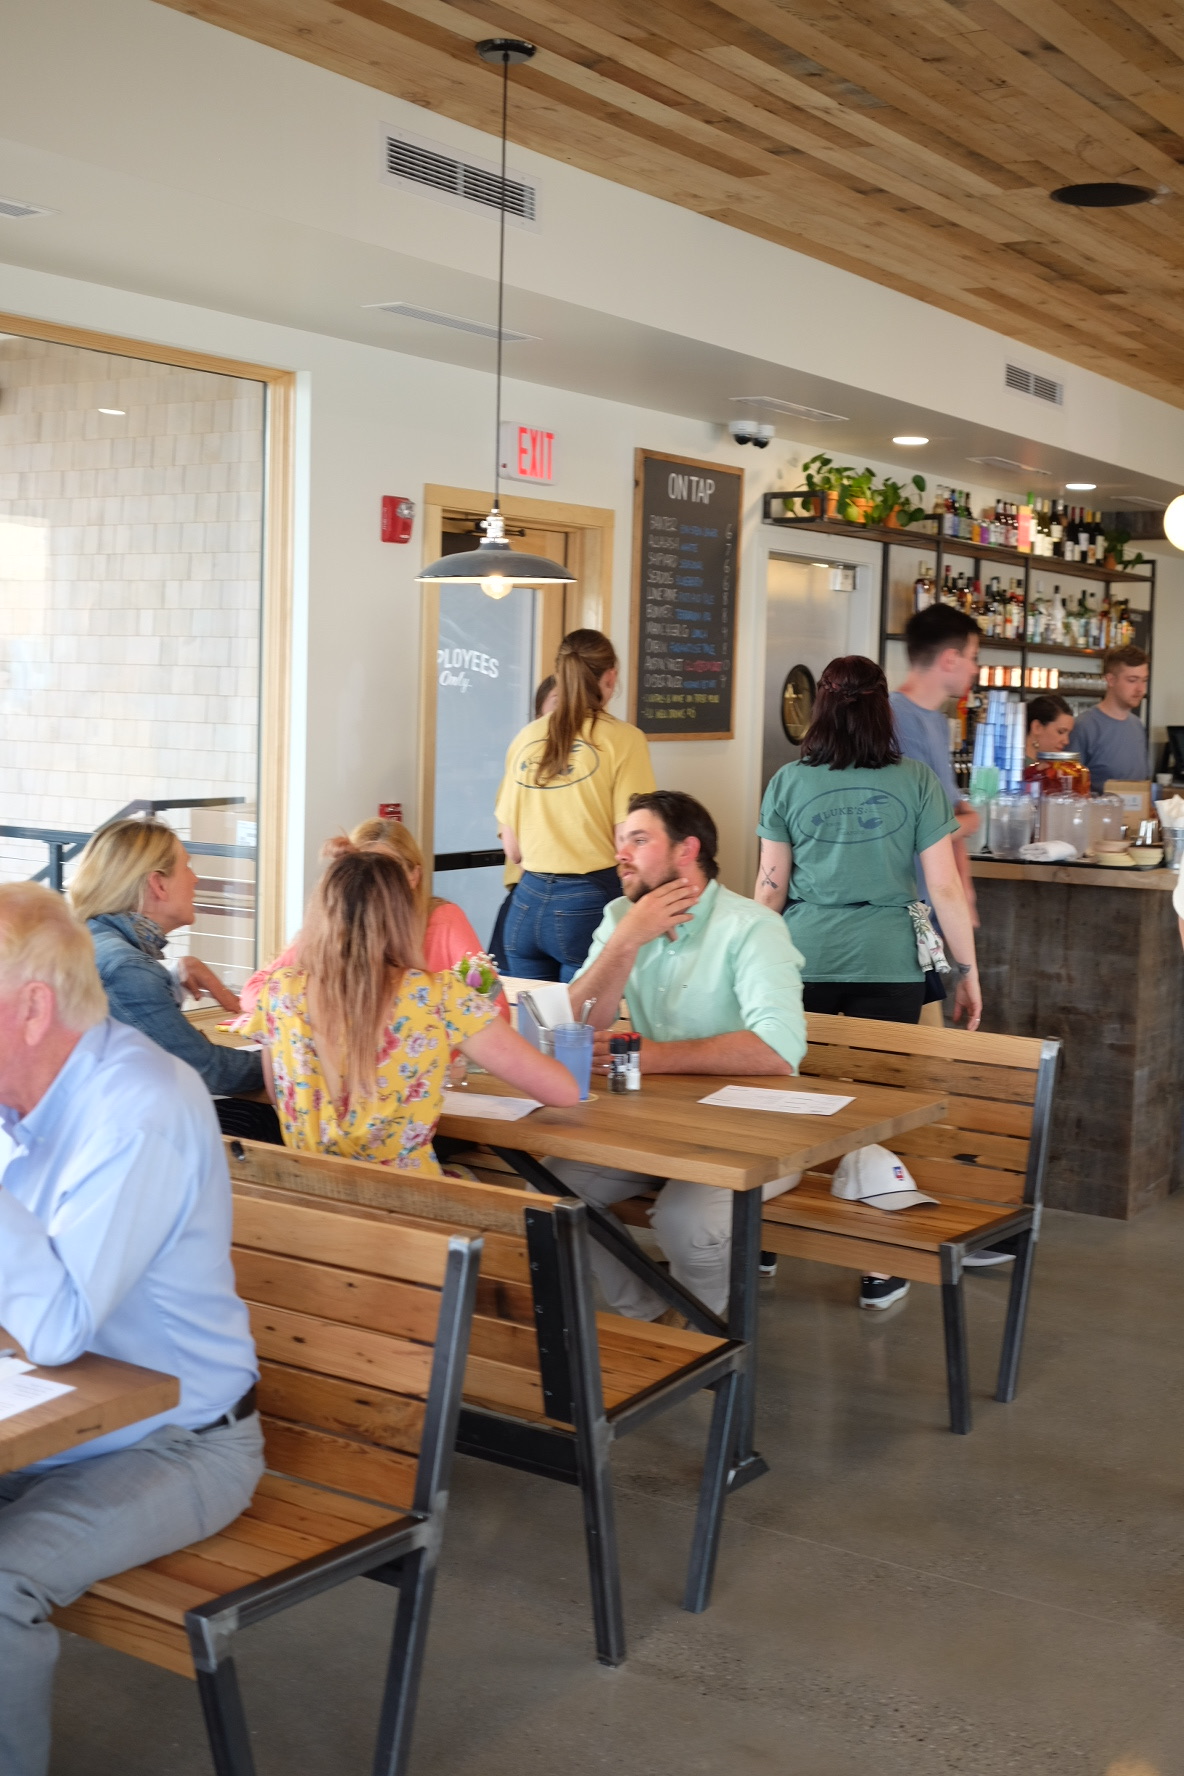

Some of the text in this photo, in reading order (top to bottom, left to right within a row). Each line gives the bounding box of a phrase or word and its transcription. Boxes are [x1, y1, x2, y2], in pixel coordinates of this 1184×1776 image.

[517, 426, 555, 480] EXIT
[668, 472, 716, 505] ON TAP
[438, 670, 472, 694] Only
[823, 806, 864, 819] LUKE'S
